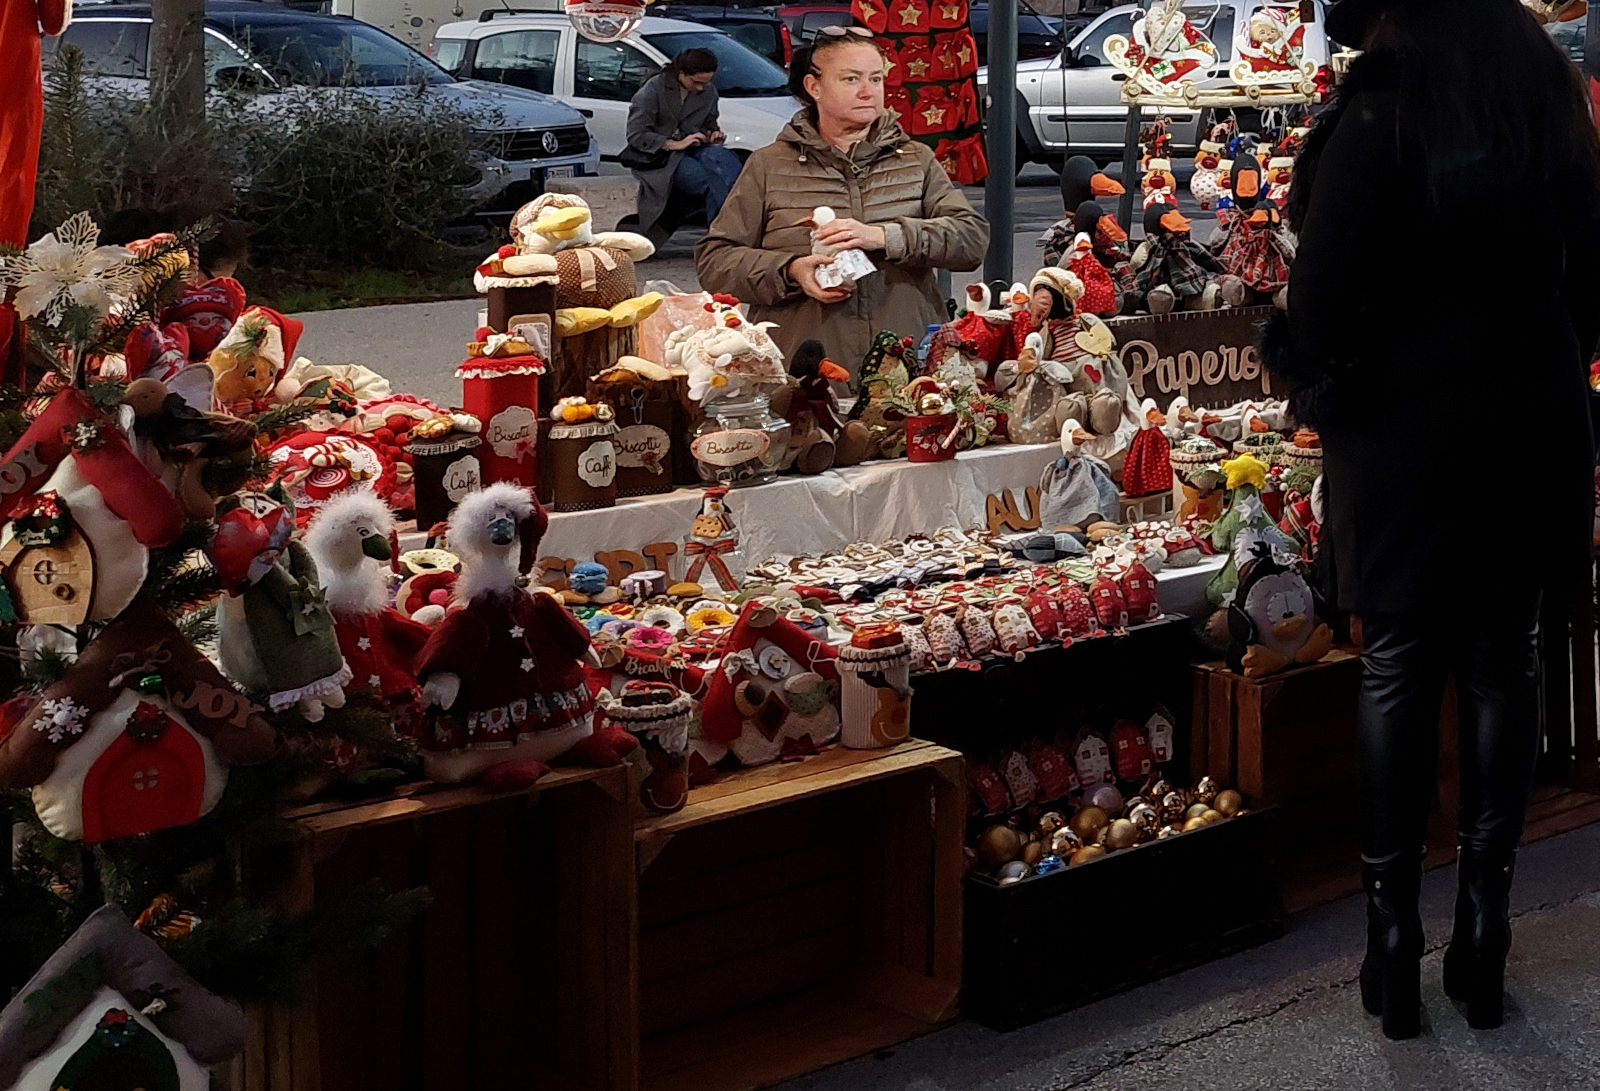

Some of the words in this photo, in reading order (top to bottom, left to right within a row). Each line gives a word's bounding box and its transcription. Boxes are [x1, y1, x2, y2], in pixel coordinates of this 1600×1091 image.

[493, 425, 530, 443] Biscotti
[613, 437, 661, 456] Biscotti
[706, 440, 754, 455] Biscotti
[0, 441, 48, 495] OY
[625, 656, 689, 680] Breakfast
[172, 679, 266, 729] JOY
